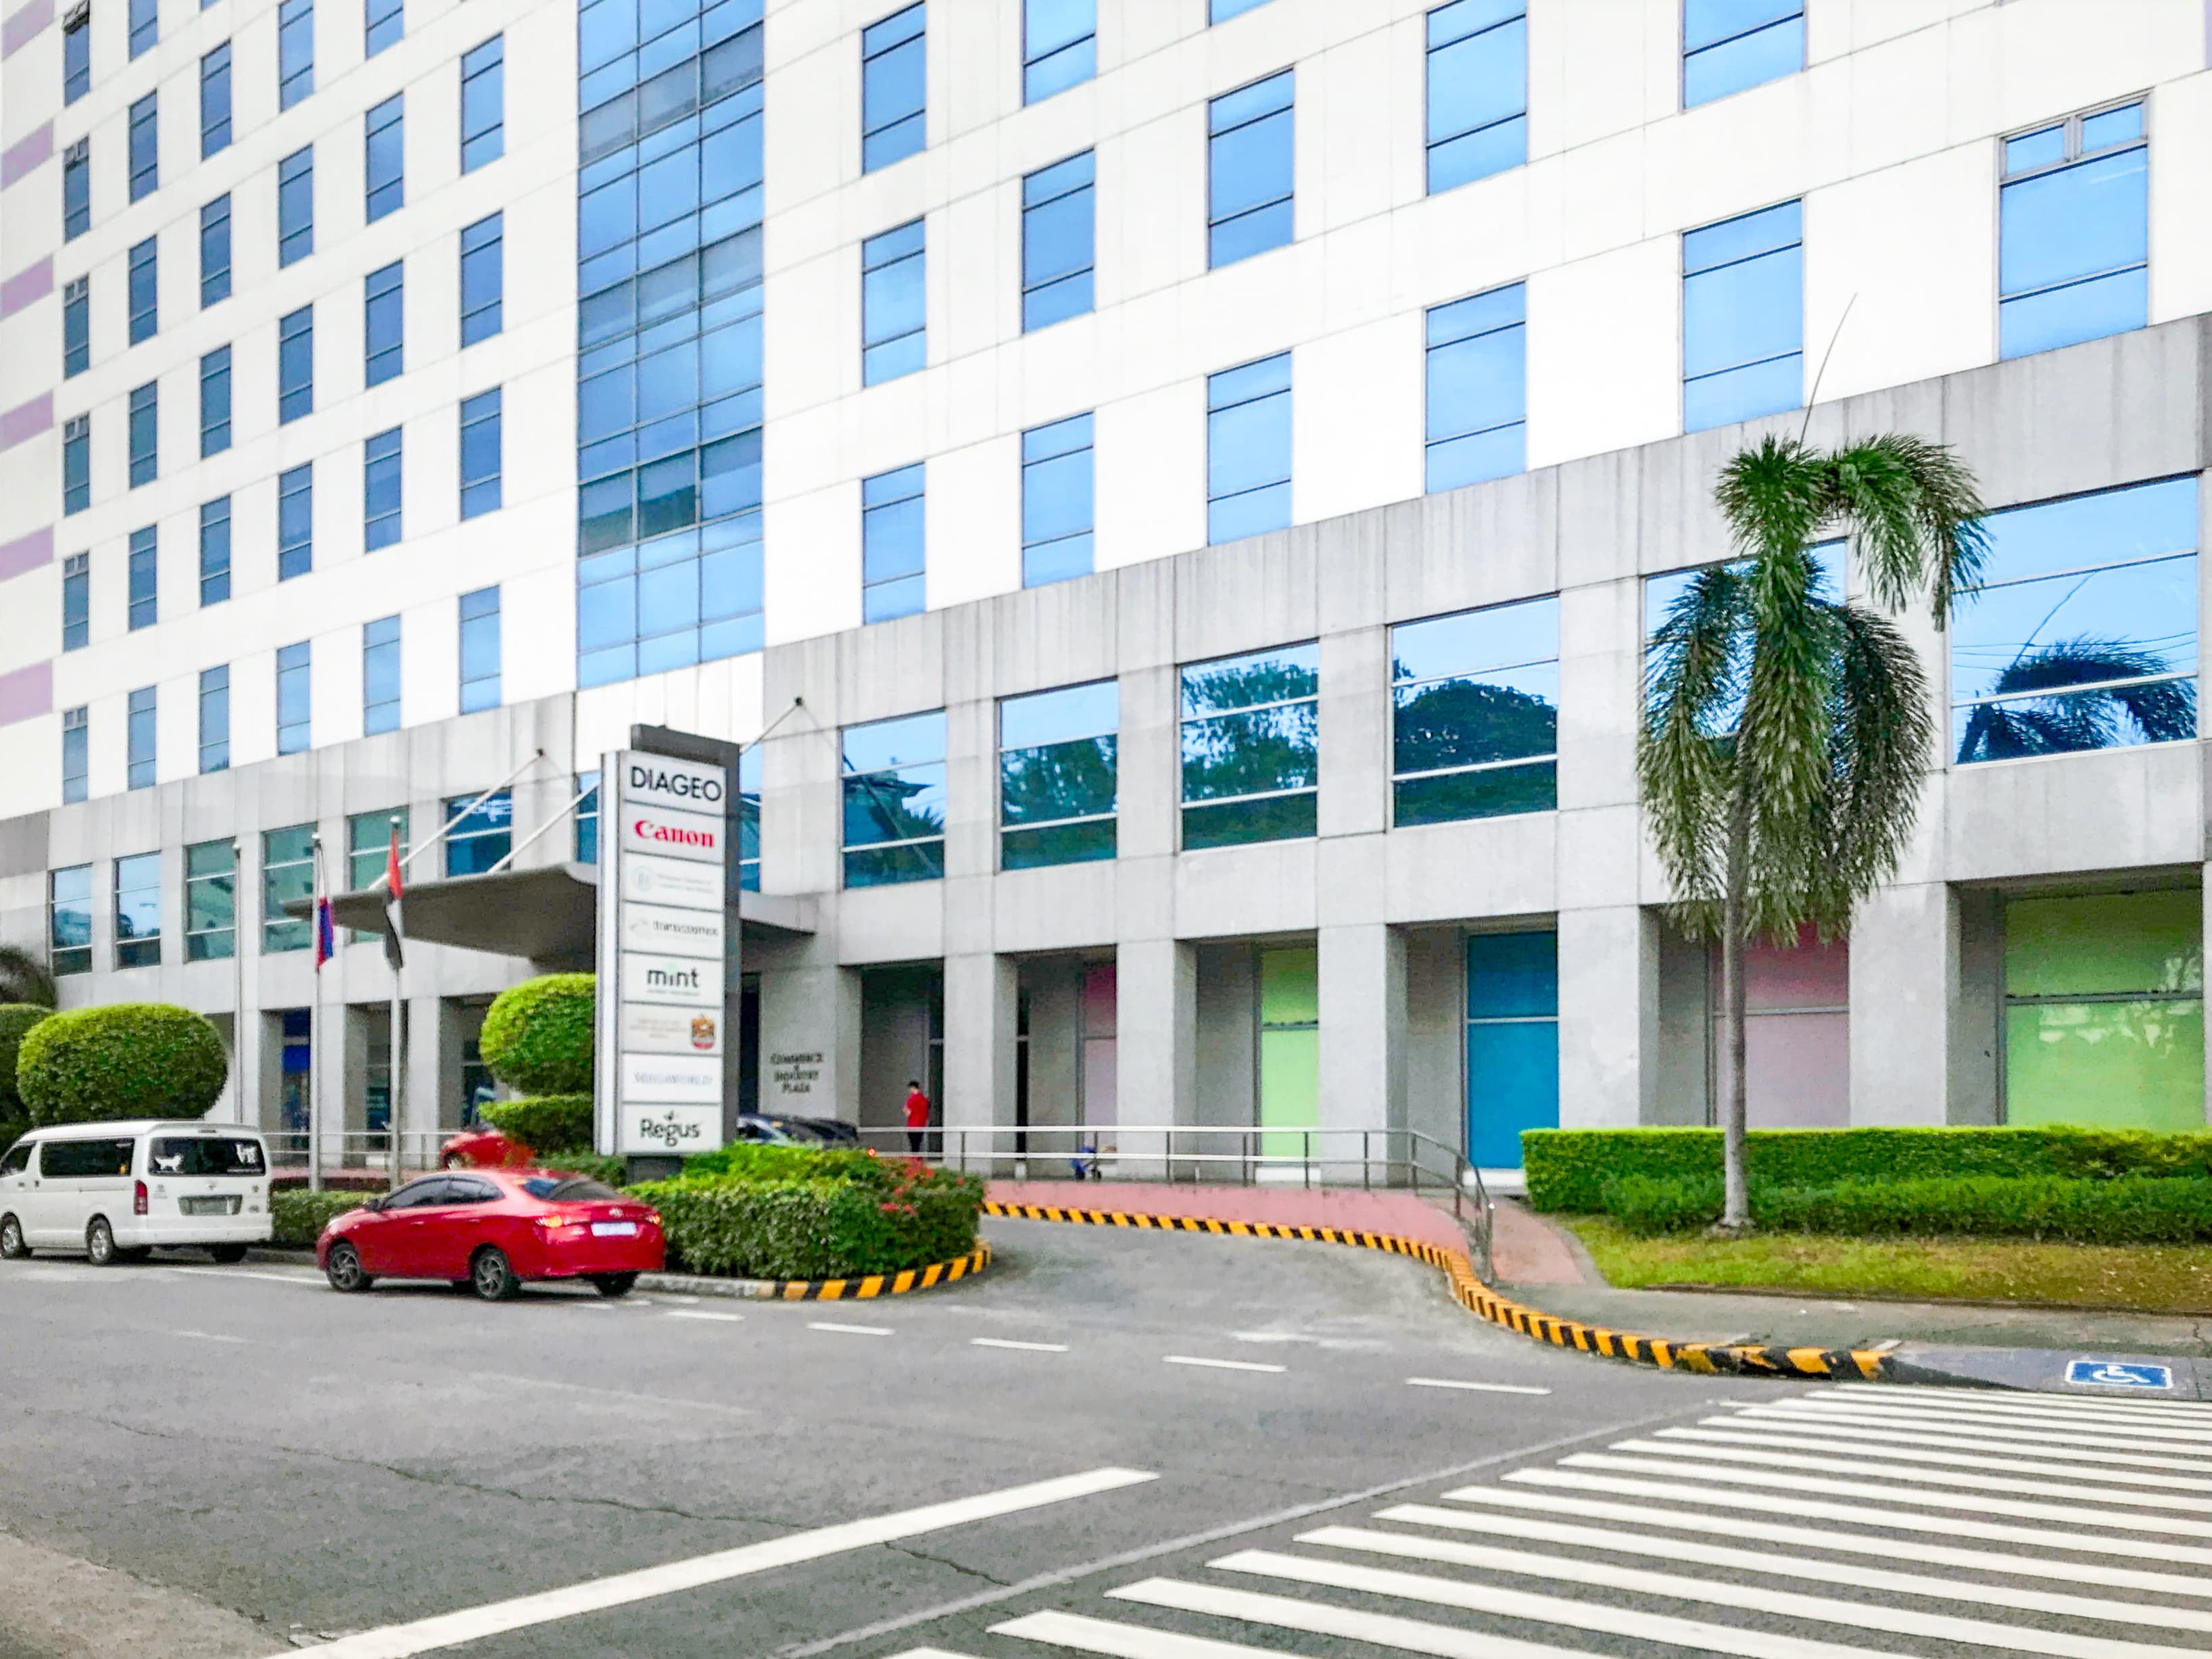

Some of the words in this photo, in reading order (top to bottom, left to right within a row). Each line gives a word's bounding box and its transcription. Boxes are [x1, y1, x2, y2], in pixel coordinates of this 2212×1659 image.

[631, 766, 721, 802] DIAGEO
[634, 819, 714, 848] Canon
[647, 967, 699, 988] mint
[640, 1118, 700, 1147] Regus
